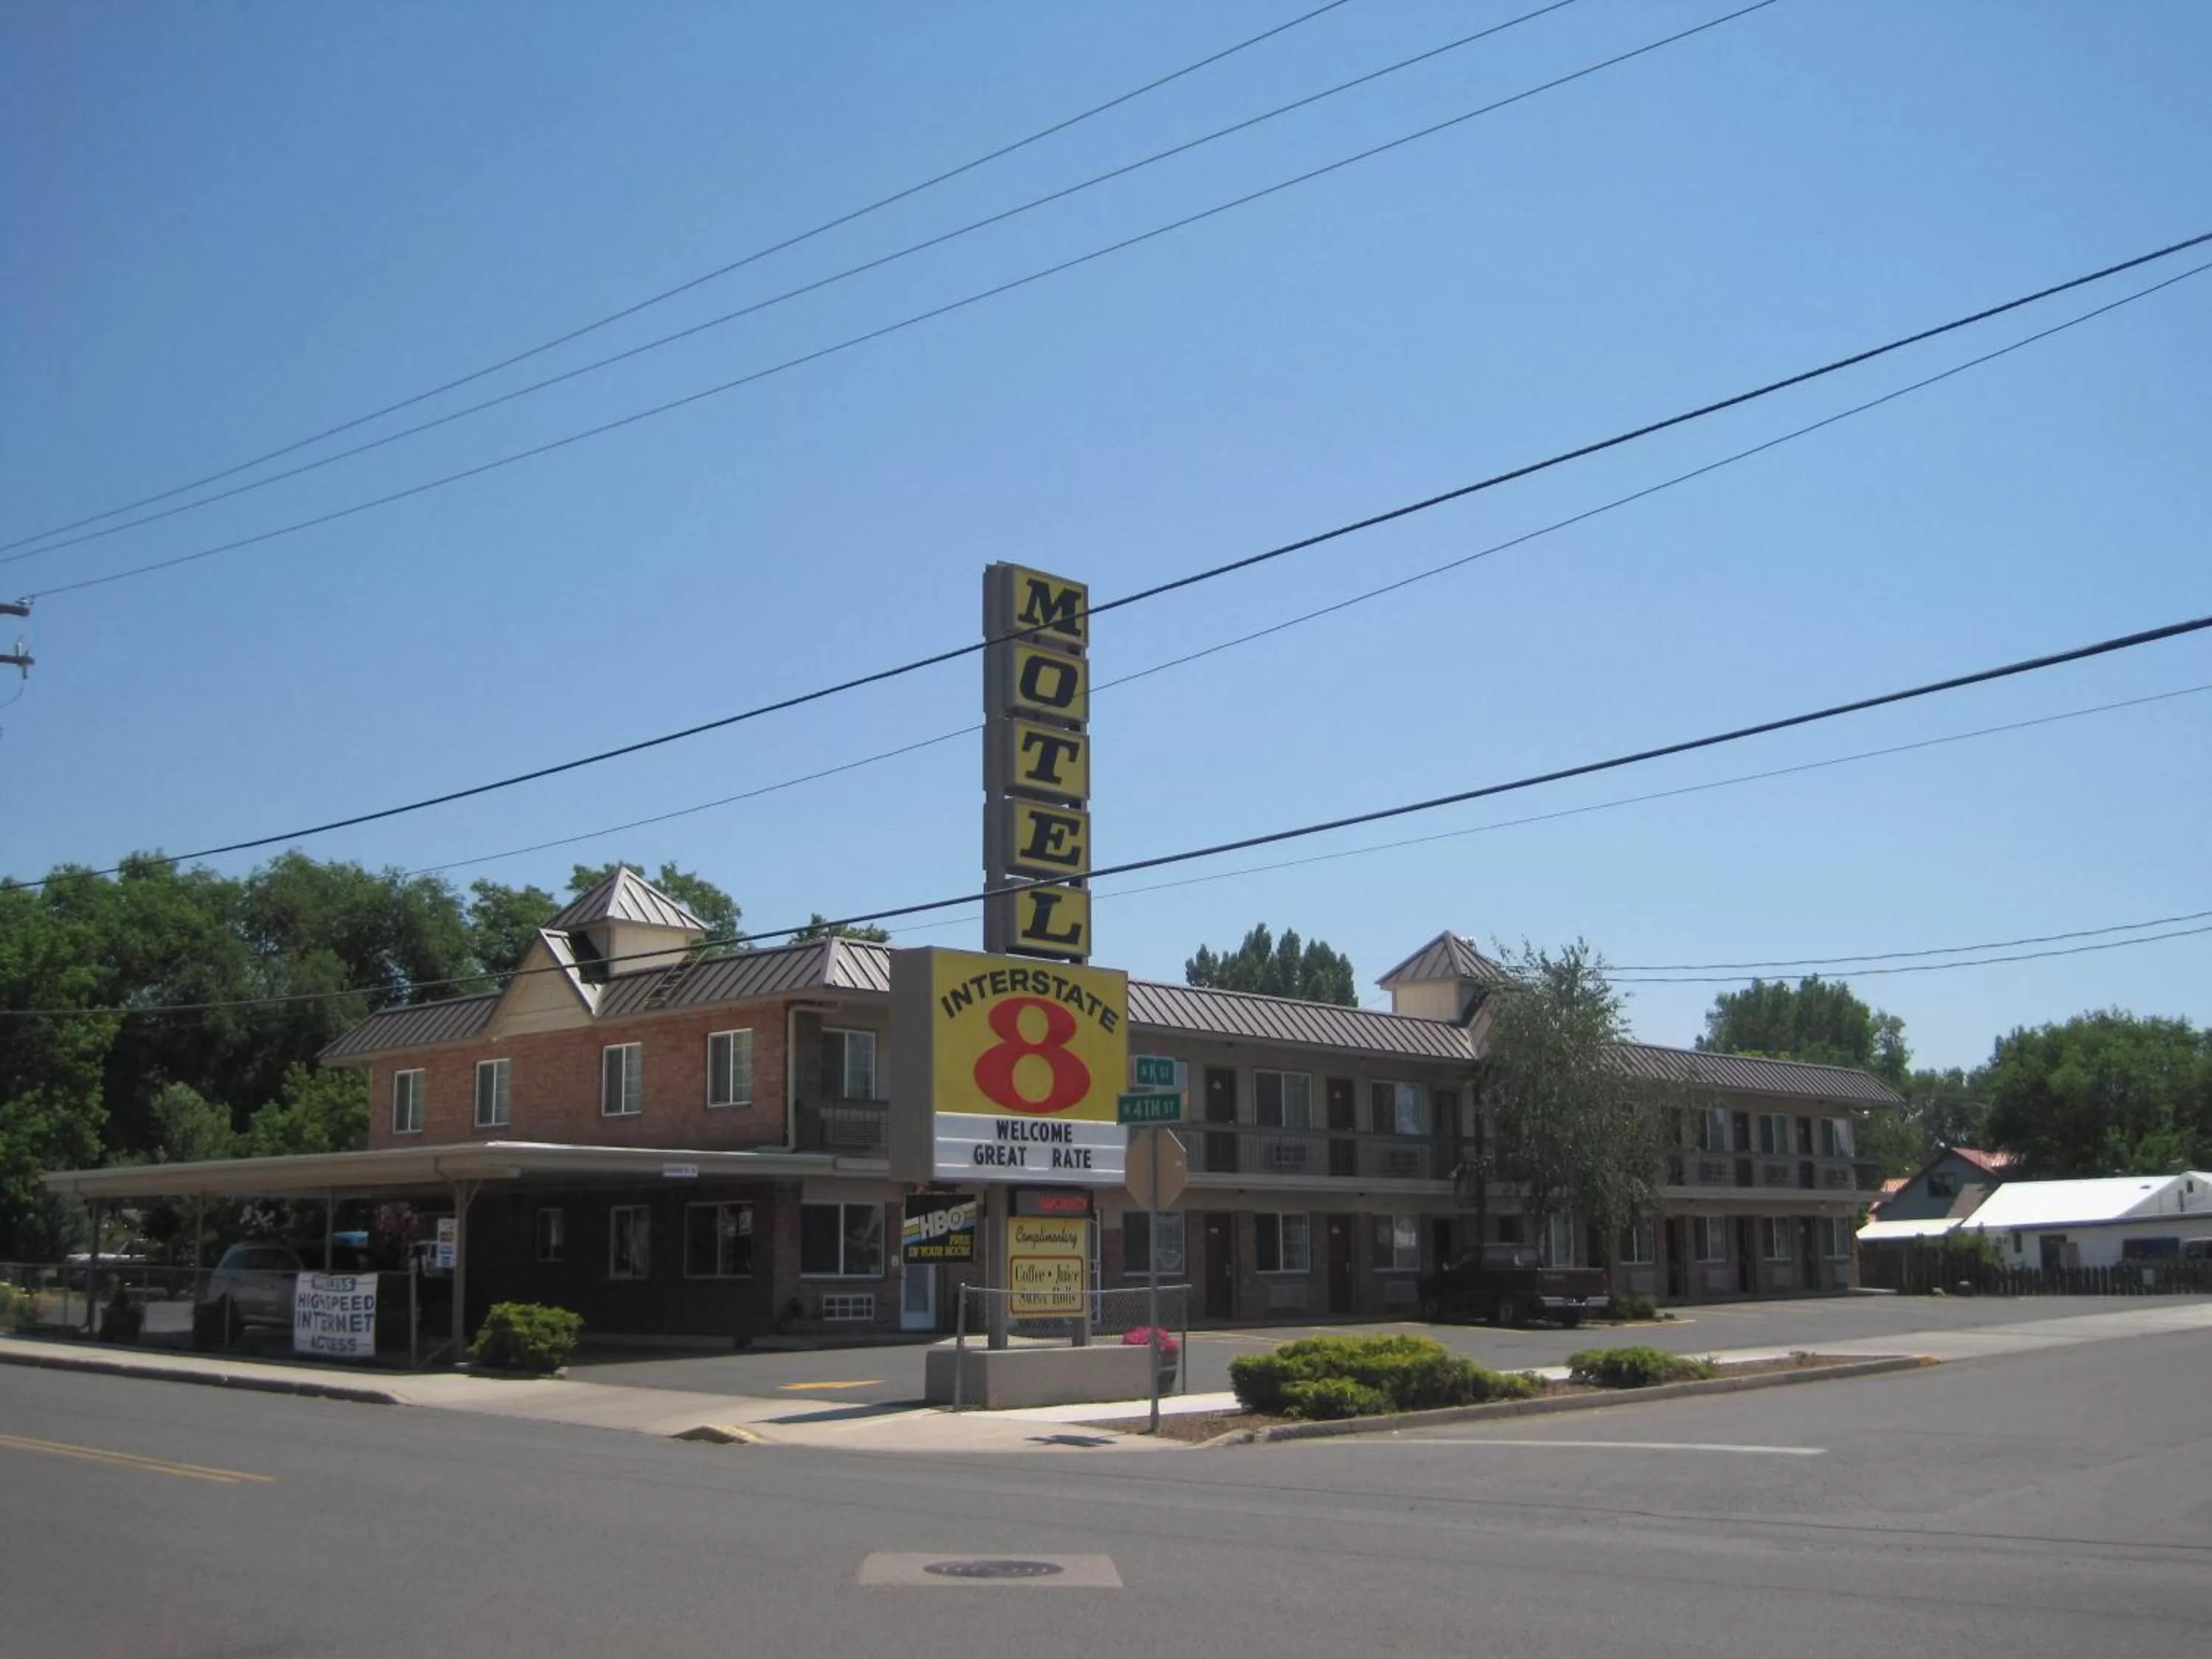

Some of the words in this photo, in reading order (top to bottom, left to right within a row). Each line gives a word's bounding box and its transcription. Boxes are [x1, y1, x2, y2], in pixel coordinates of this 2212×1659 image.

[1017, 577, 1083, 946] MOTEL
[939, 968, 1121, 1034] INTERSTATE
[973, 996, 1091, 1114] 8
[1133, 1099, 1161, 1120] 4TH
[995, 1119, 1074, 1144] WELCOME
[973, 1144, 1027, 1167] GREAT
[1051, 1147, 1093, 1169] RATE
[919, 1206, 965, 1239] HBO
[296, 1310, 375, 1333] INTERNET
